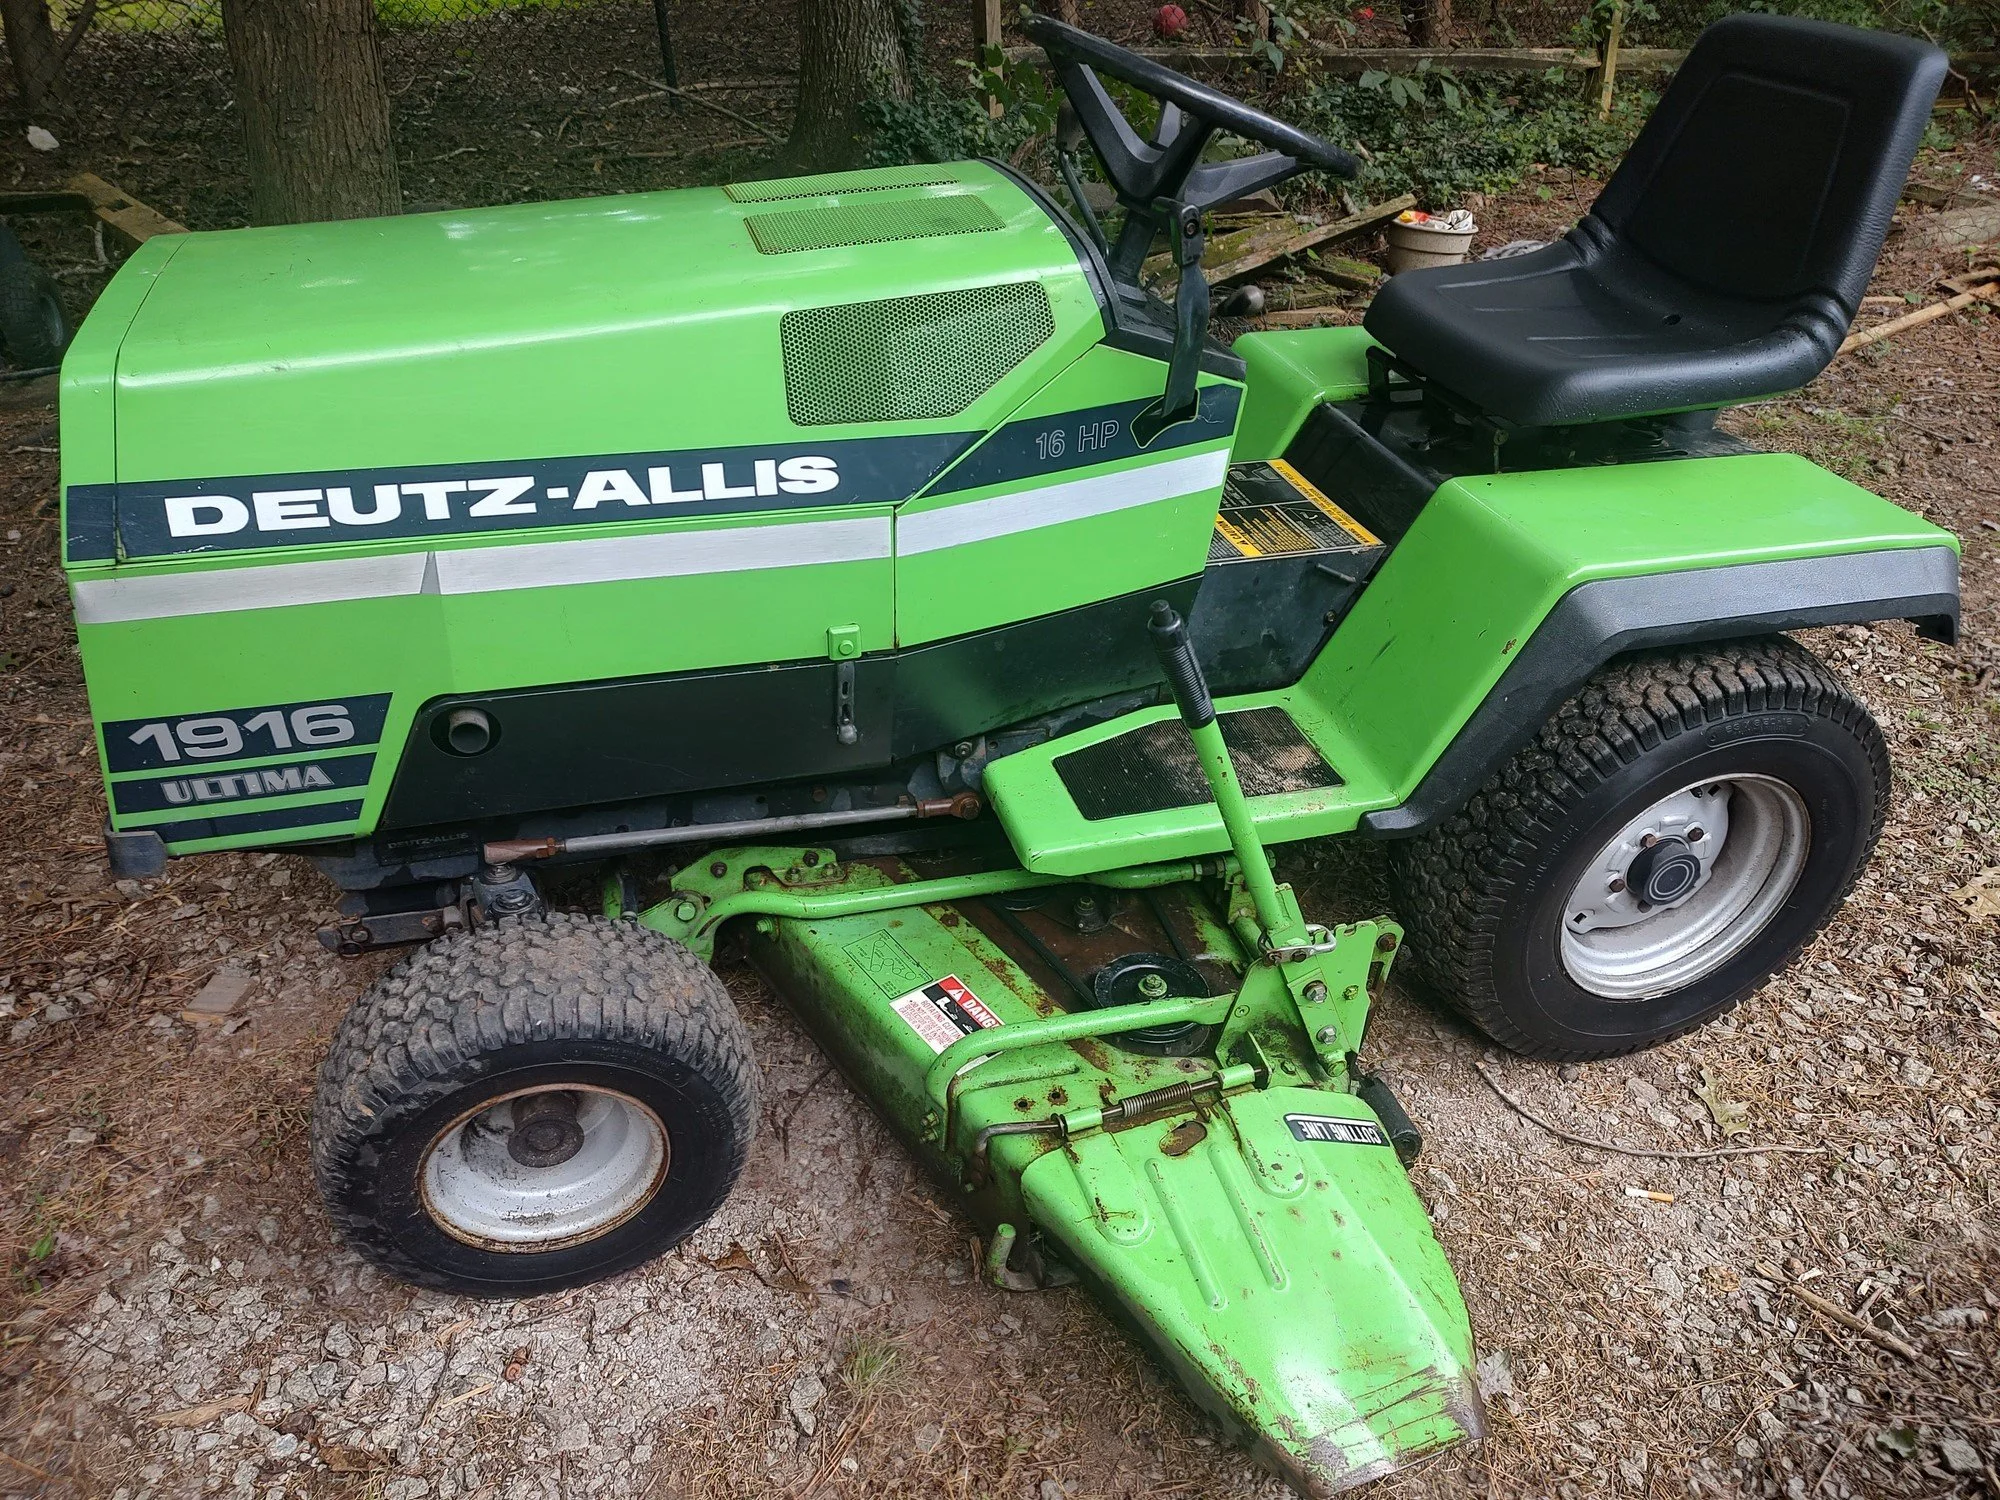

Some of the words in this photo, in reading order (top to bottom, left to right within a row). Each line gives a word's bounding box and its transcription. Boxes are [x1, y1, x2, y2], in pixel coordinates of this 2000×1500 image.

[1035, 429, 1065, 459] 16
[1078, 420, 1119, 452] HP
[163, 455, 840, 538] DEUTZ-ALLIS
[1216, 520, 1242, 544] CAUTION
[128, 705, 355, 761] 1916
[160, 765, 334, 804] ULTIMA
[387, 832, 469, 849] DEUTZ-ALLIS
[962, 999, 1000, 1029] DANG
[941, 1020, 963, 1039] CUTTIN
[1298, 1121, 1331, 1140] LINE
[1330, 1123, 1381, 1144] CUTTING
